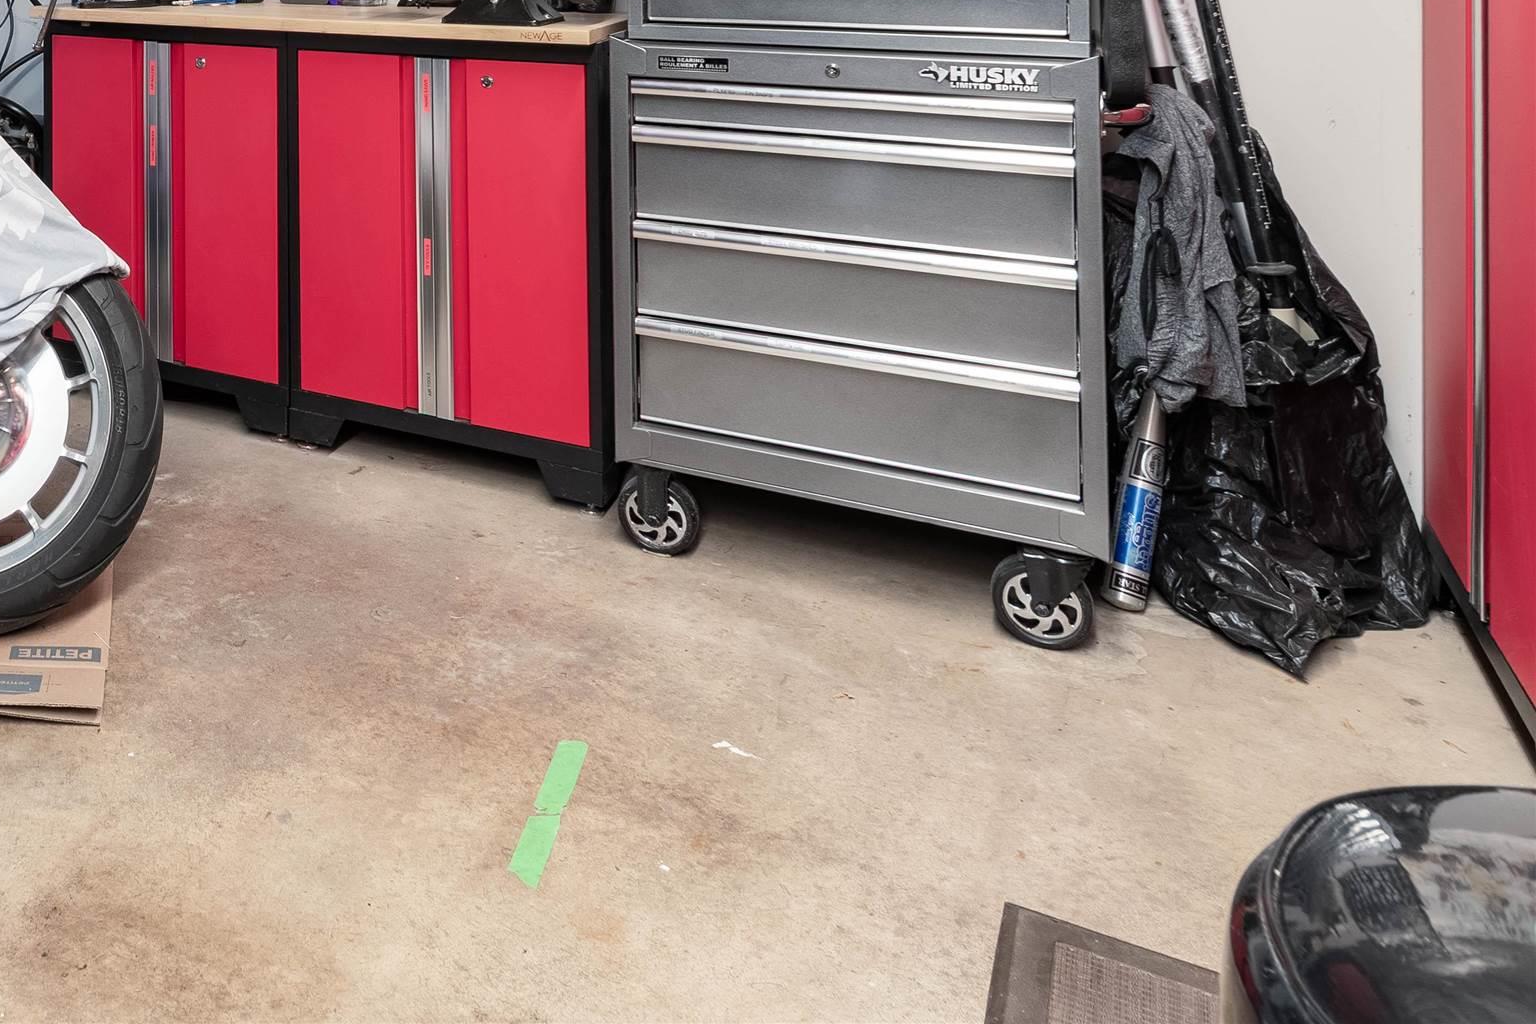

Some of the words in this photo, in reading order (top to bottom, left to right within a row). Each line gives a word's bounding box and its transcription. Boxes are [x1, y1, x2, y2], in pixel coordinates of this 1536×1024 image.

[519, 30, 564, 42] NEWAGE
[949, 65, 1041, 85] HUSKY
[950, 81, 993, 91] LIMITED
[995, 83, 1039, 93] EDITION
[17, 647, 94, 660] PETITE
